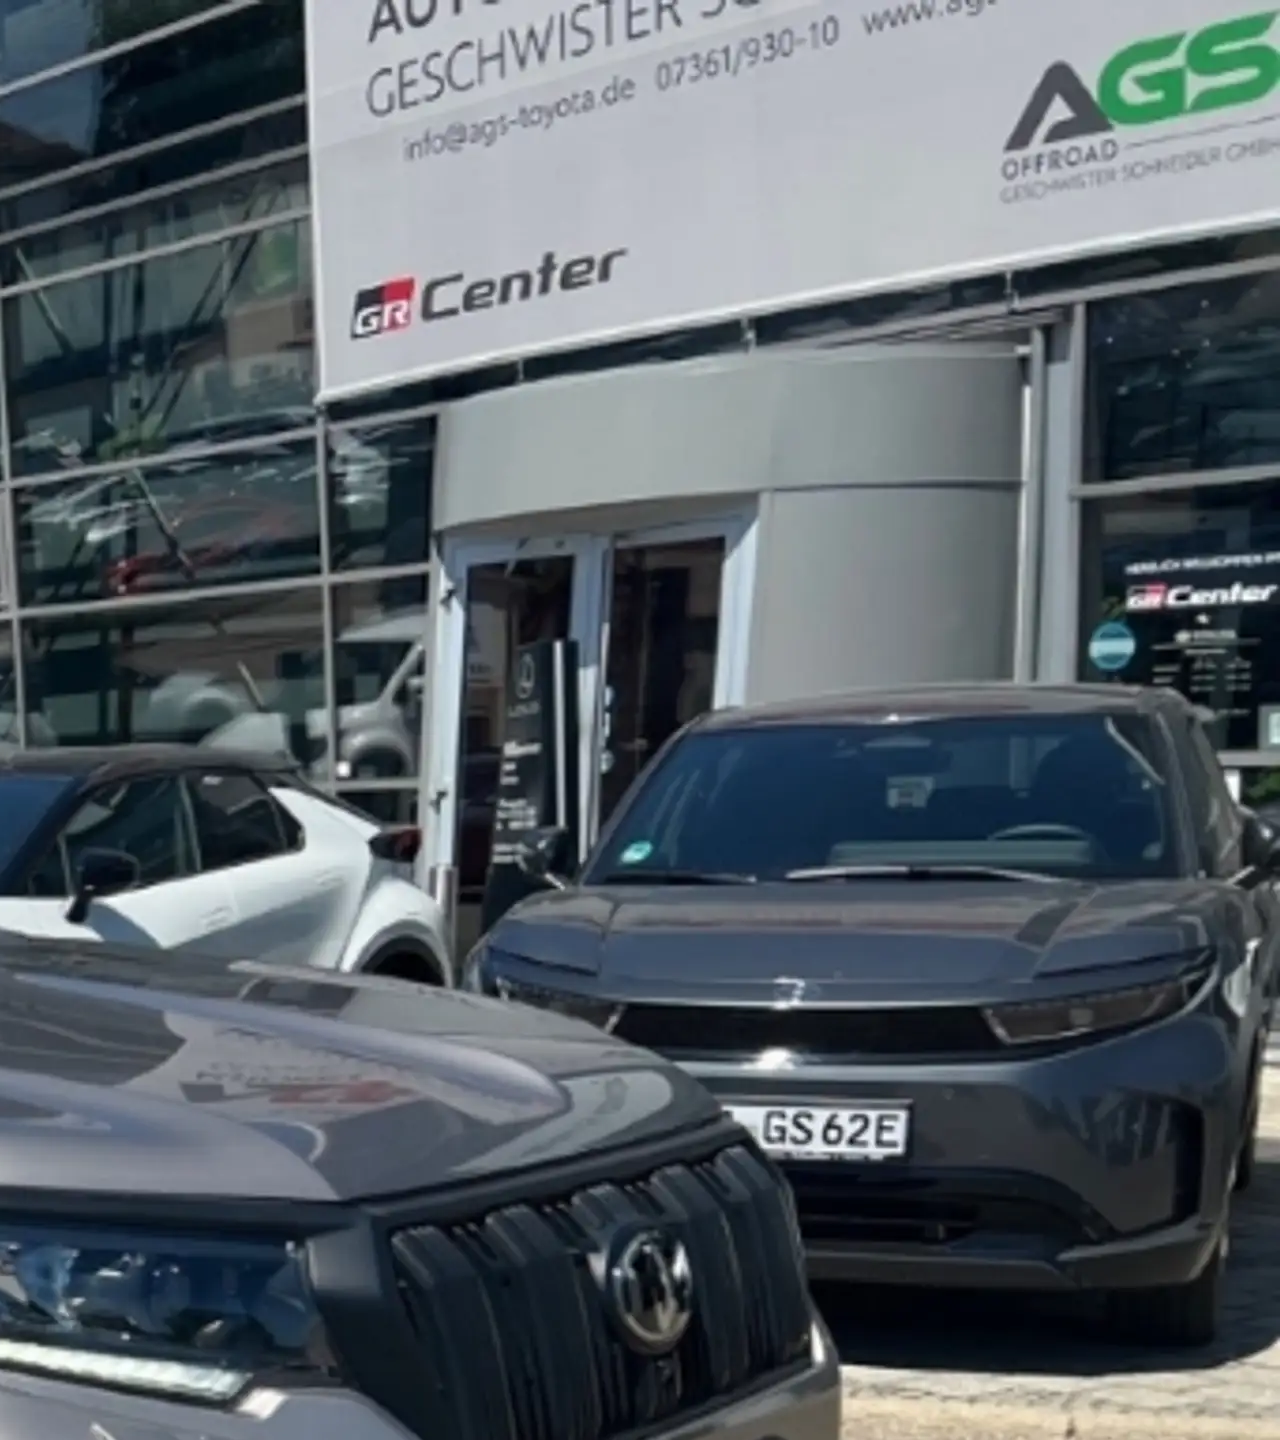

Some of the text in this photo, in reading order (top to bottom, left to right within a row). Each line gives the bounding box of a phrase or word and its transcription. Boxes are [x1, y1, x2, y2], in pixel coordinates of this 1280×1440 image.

[366, 0, 683, 117] GESCHWISTER
[403, 75, 636, 161] info@ags-toyota.de
[655, 15, 840, 90] 07361/930-10
[1003, 9, 1280, 153] AGS
[1001, 138, 1119, 180] OFFROAD
[351, 248, 629, 339] GR Center
[1167, 582, 1279, 608] Center
